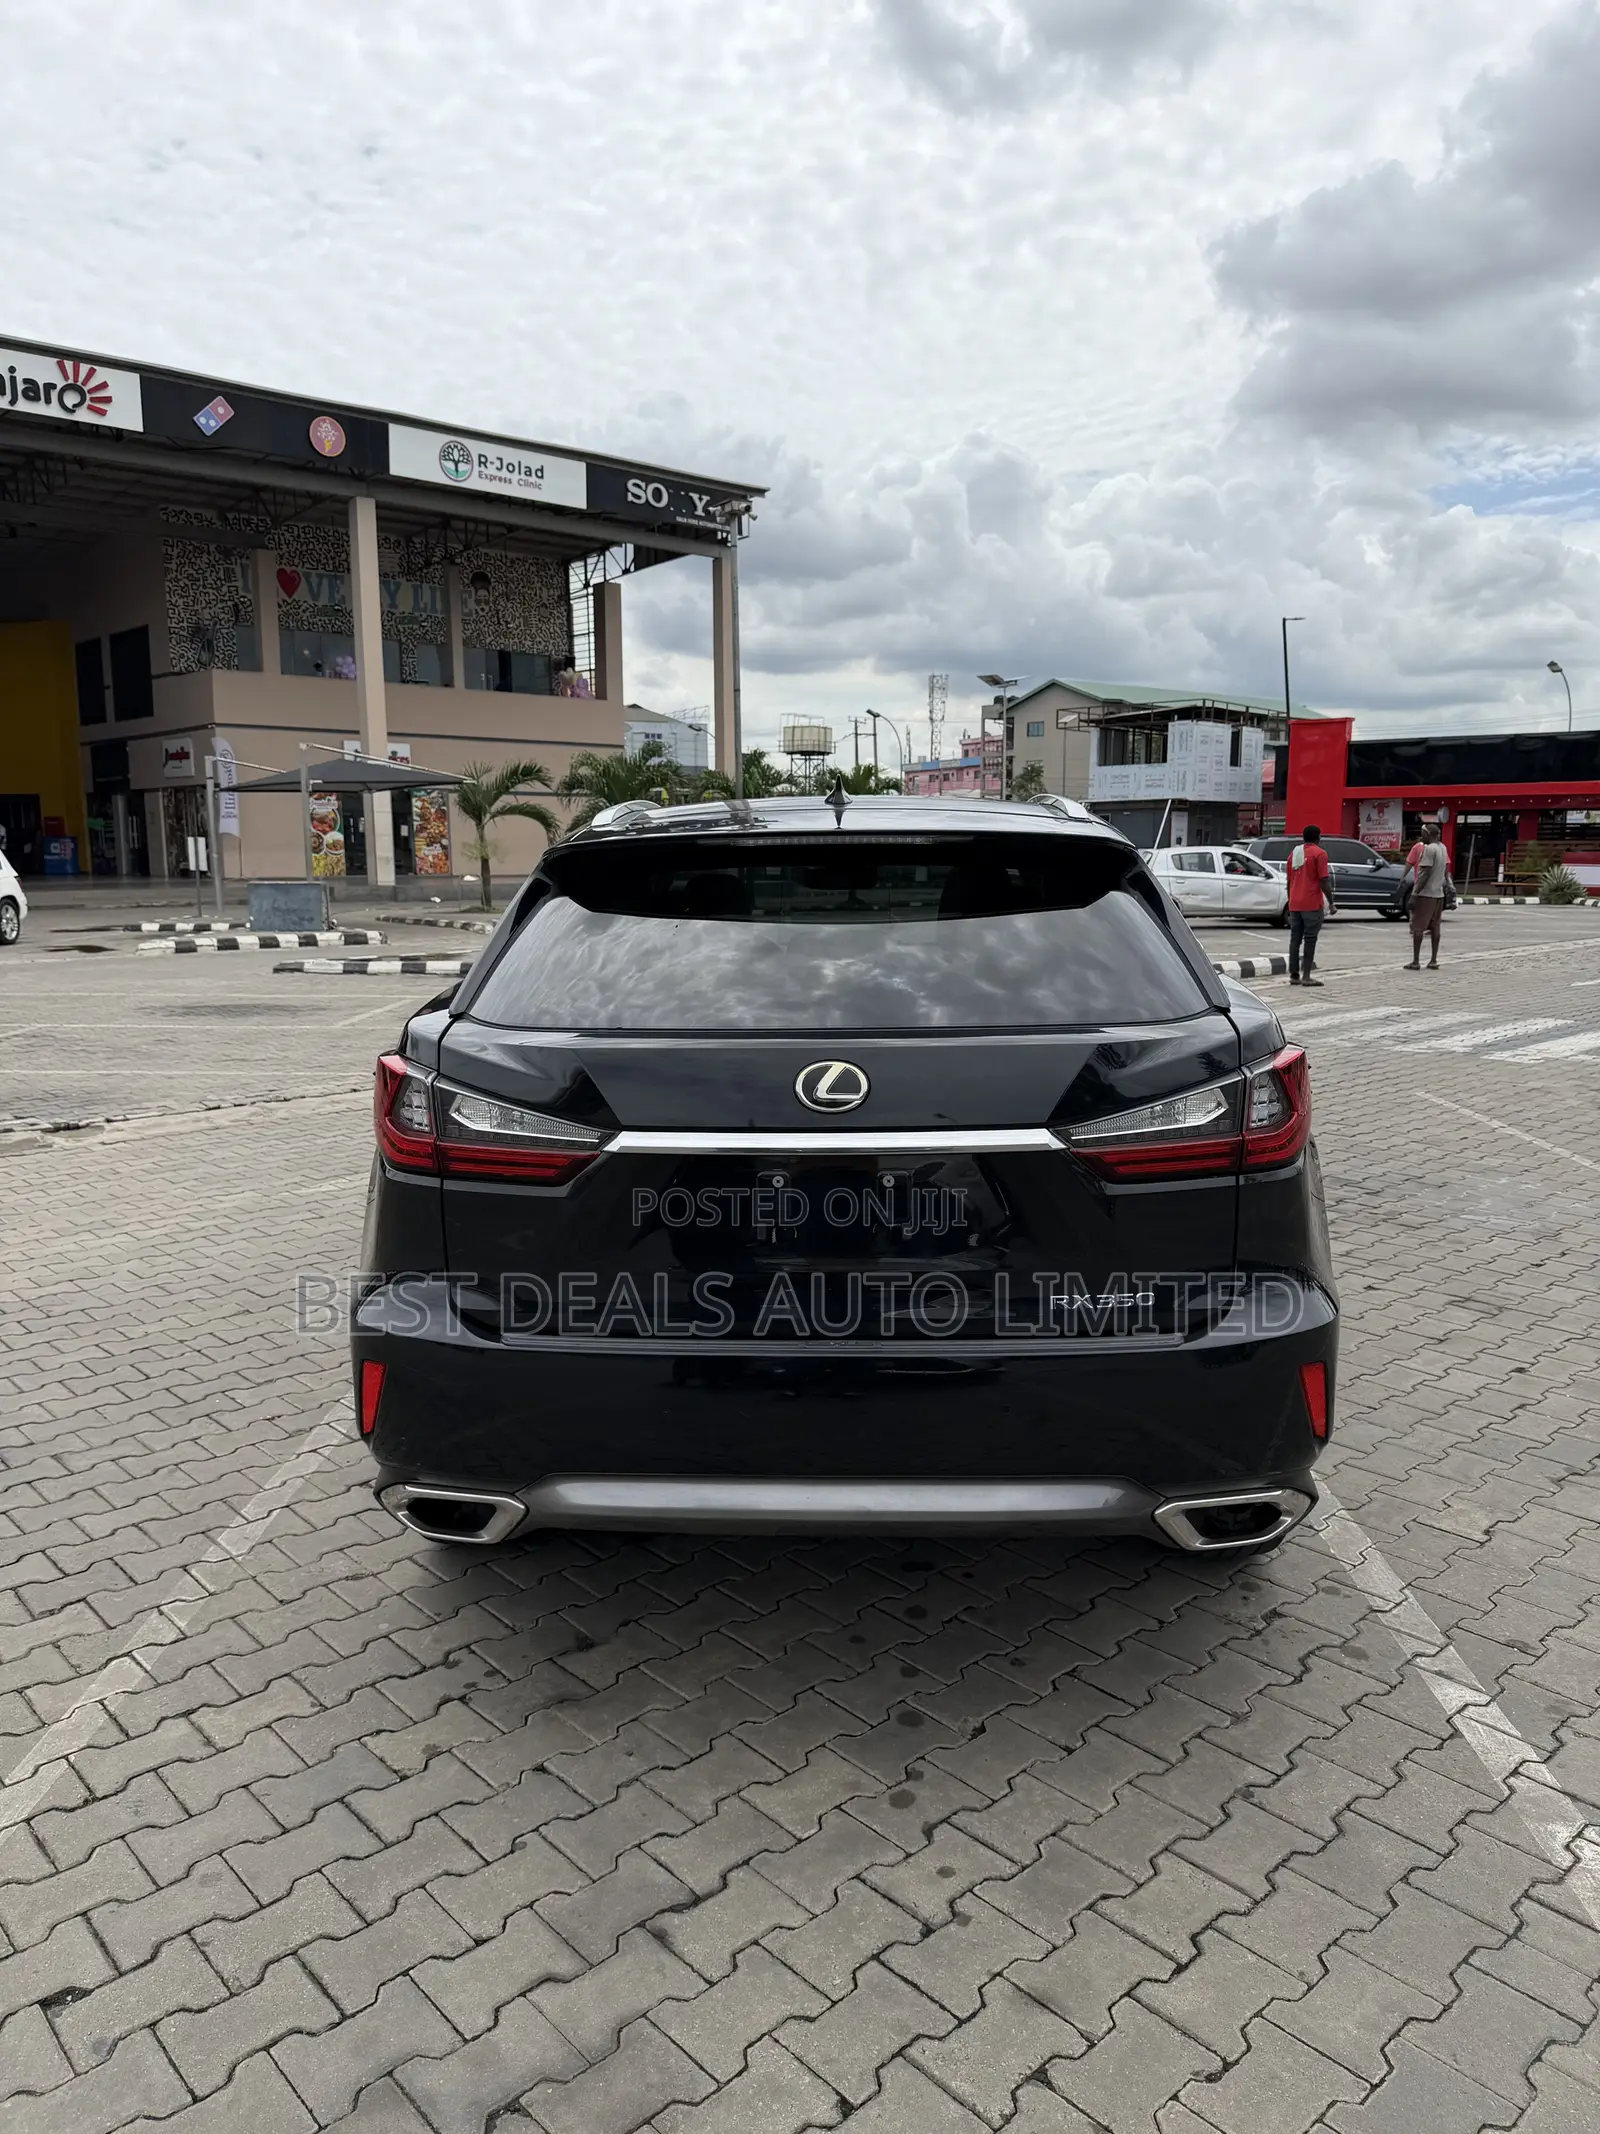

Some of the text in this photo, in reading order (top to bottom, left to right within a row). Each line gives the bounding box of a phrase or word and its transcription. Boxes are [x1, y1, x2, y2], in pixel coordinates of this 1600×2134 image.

[477, 453, 544, 480] R-Jolad
[478, 470, 543, 490] Express Clinic
[626, 478, 710, 516] SOY
